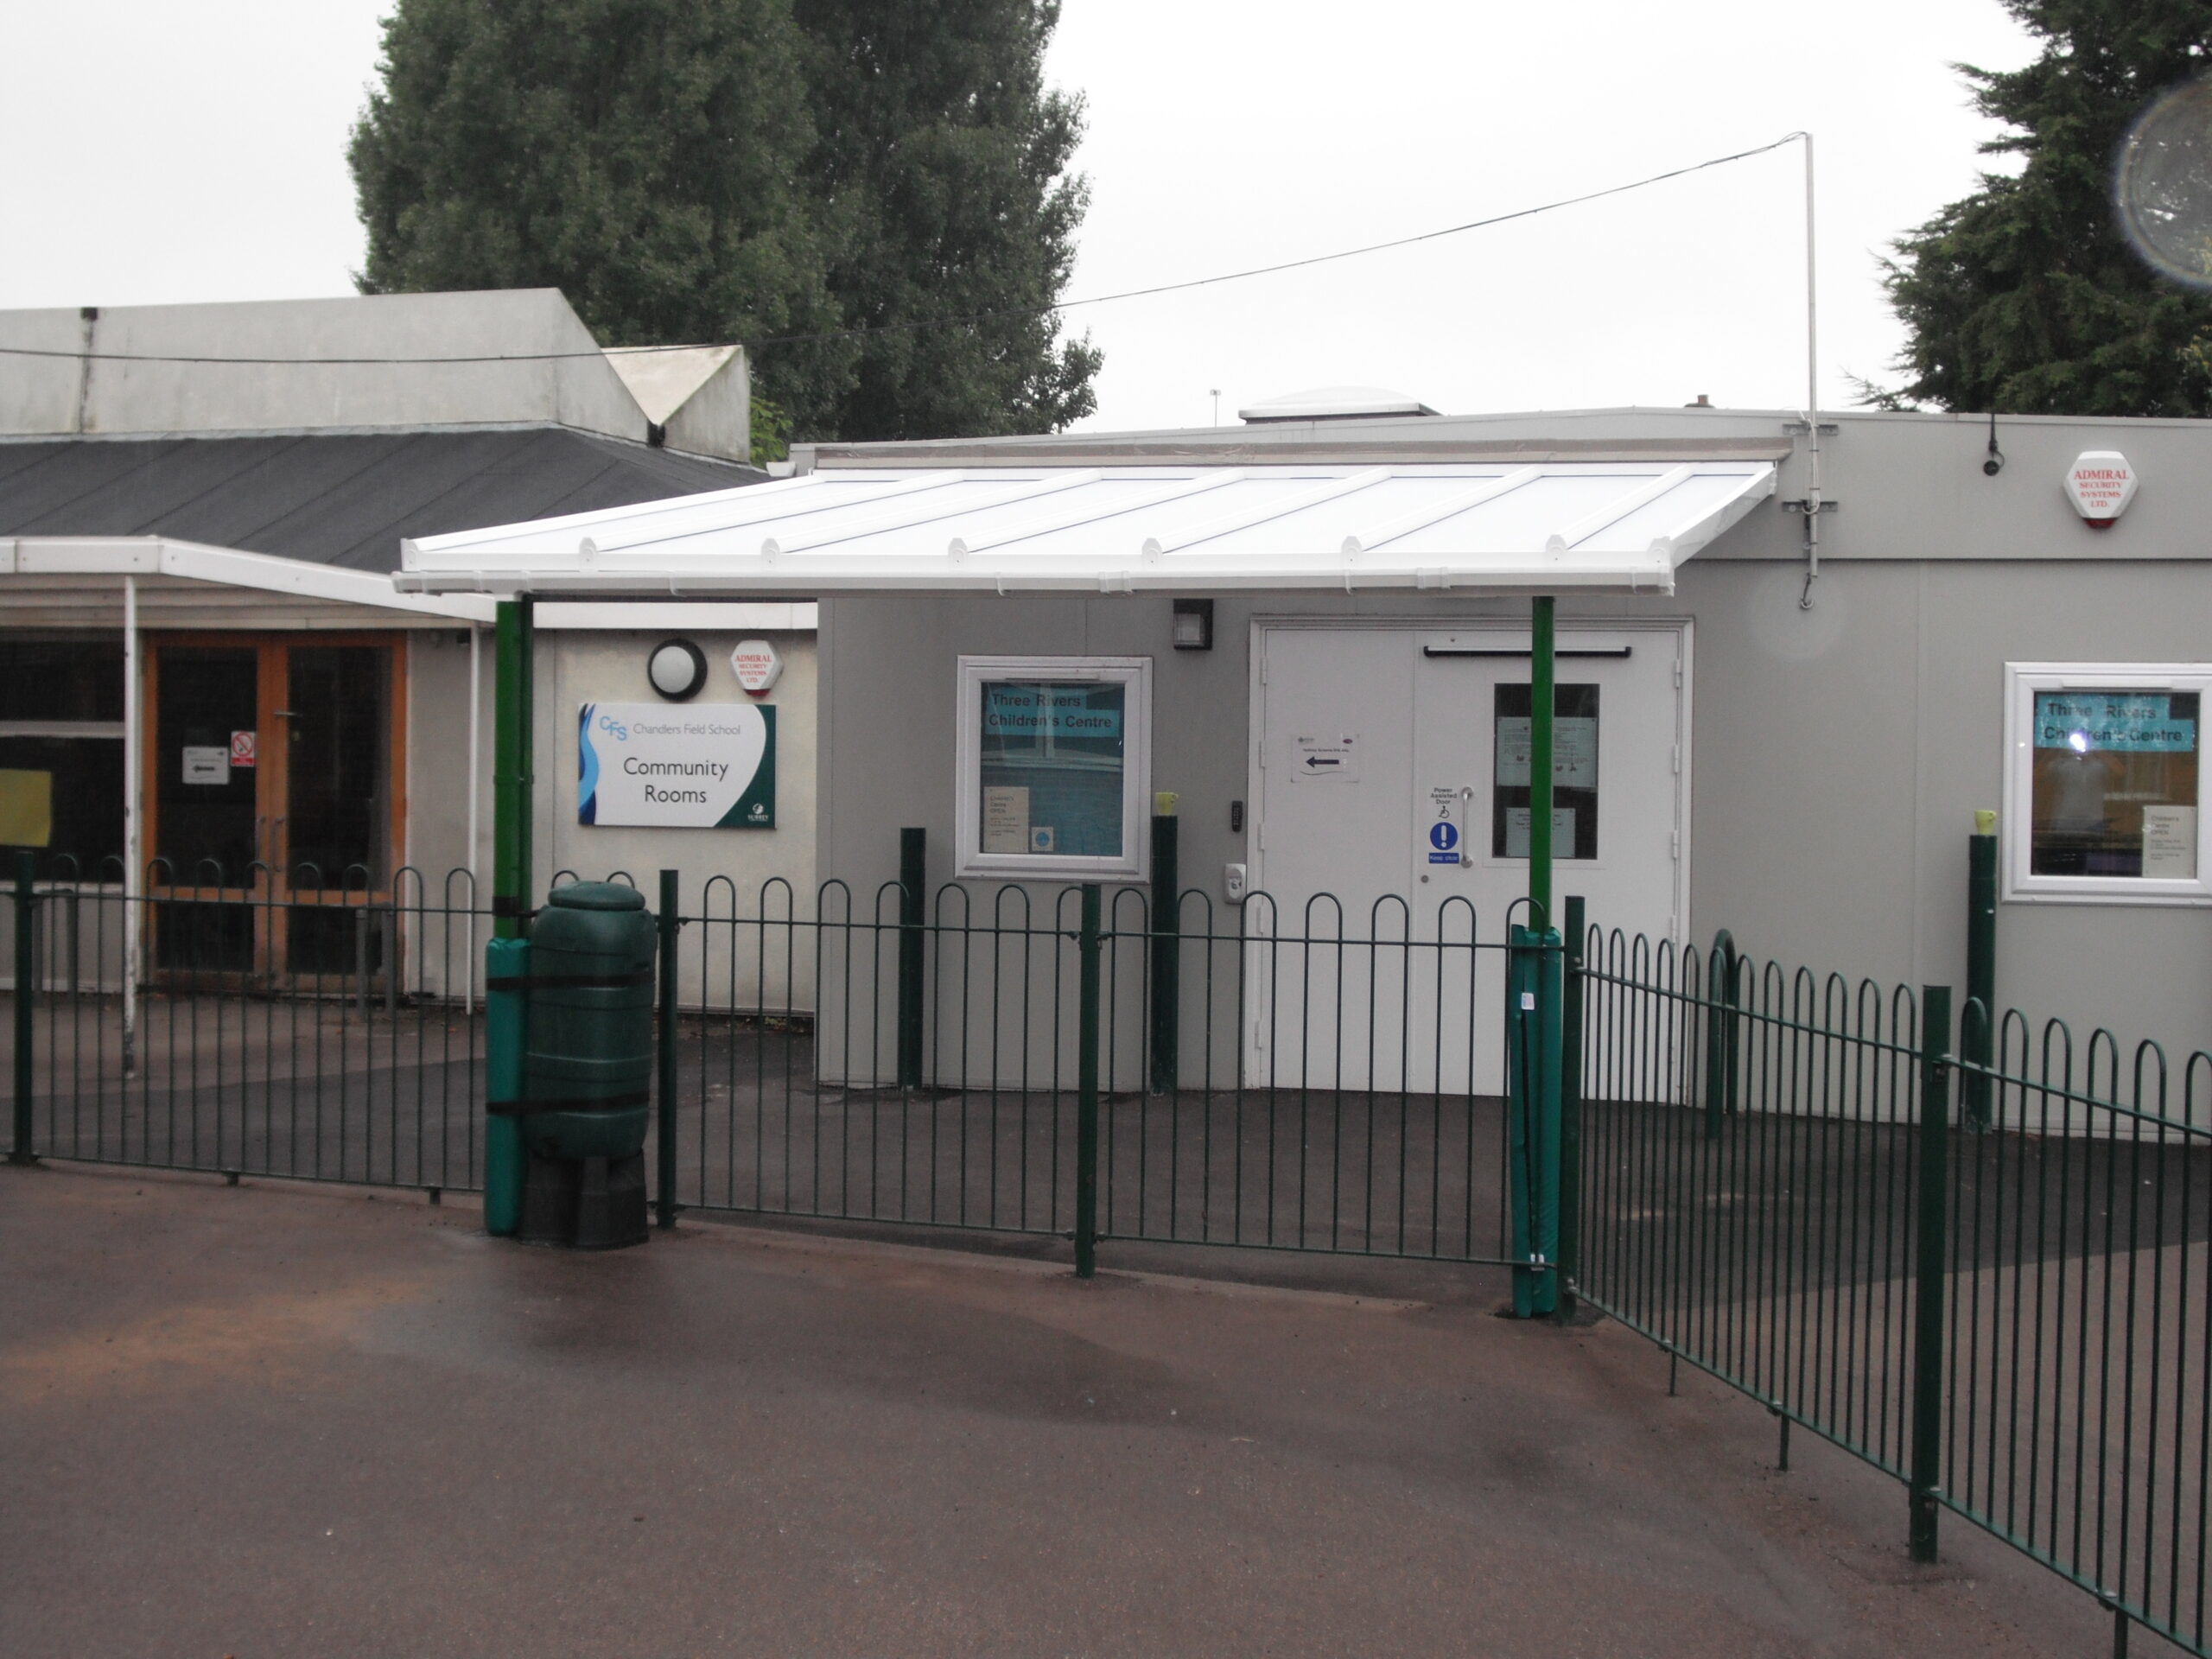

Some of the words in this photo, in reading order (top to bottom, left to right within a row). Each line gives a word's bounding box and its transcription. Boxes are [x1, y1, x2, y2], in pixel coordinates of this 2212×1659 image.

[2074, 469, 2130, 480] ADMIRAL
[734, 654, 772, 663] ADMIRAL
[993, 694, 1031, 707] Three
[1037, 695, 1081, 707] Rivers
[599, 715, 627, 741] CFS
[988, 715, 1060, 728] Children's
[1065, 715, 1113, 728] Centre
[632, 723, 681, 734] Chandlers
[684, 723, 705, 734] Field
[708, 723, 741, 735] School
[2130, 728, 2183, 741] Centre
[624, 757, 729, 782] Community
[645, 785, 707, 804] Rooms
